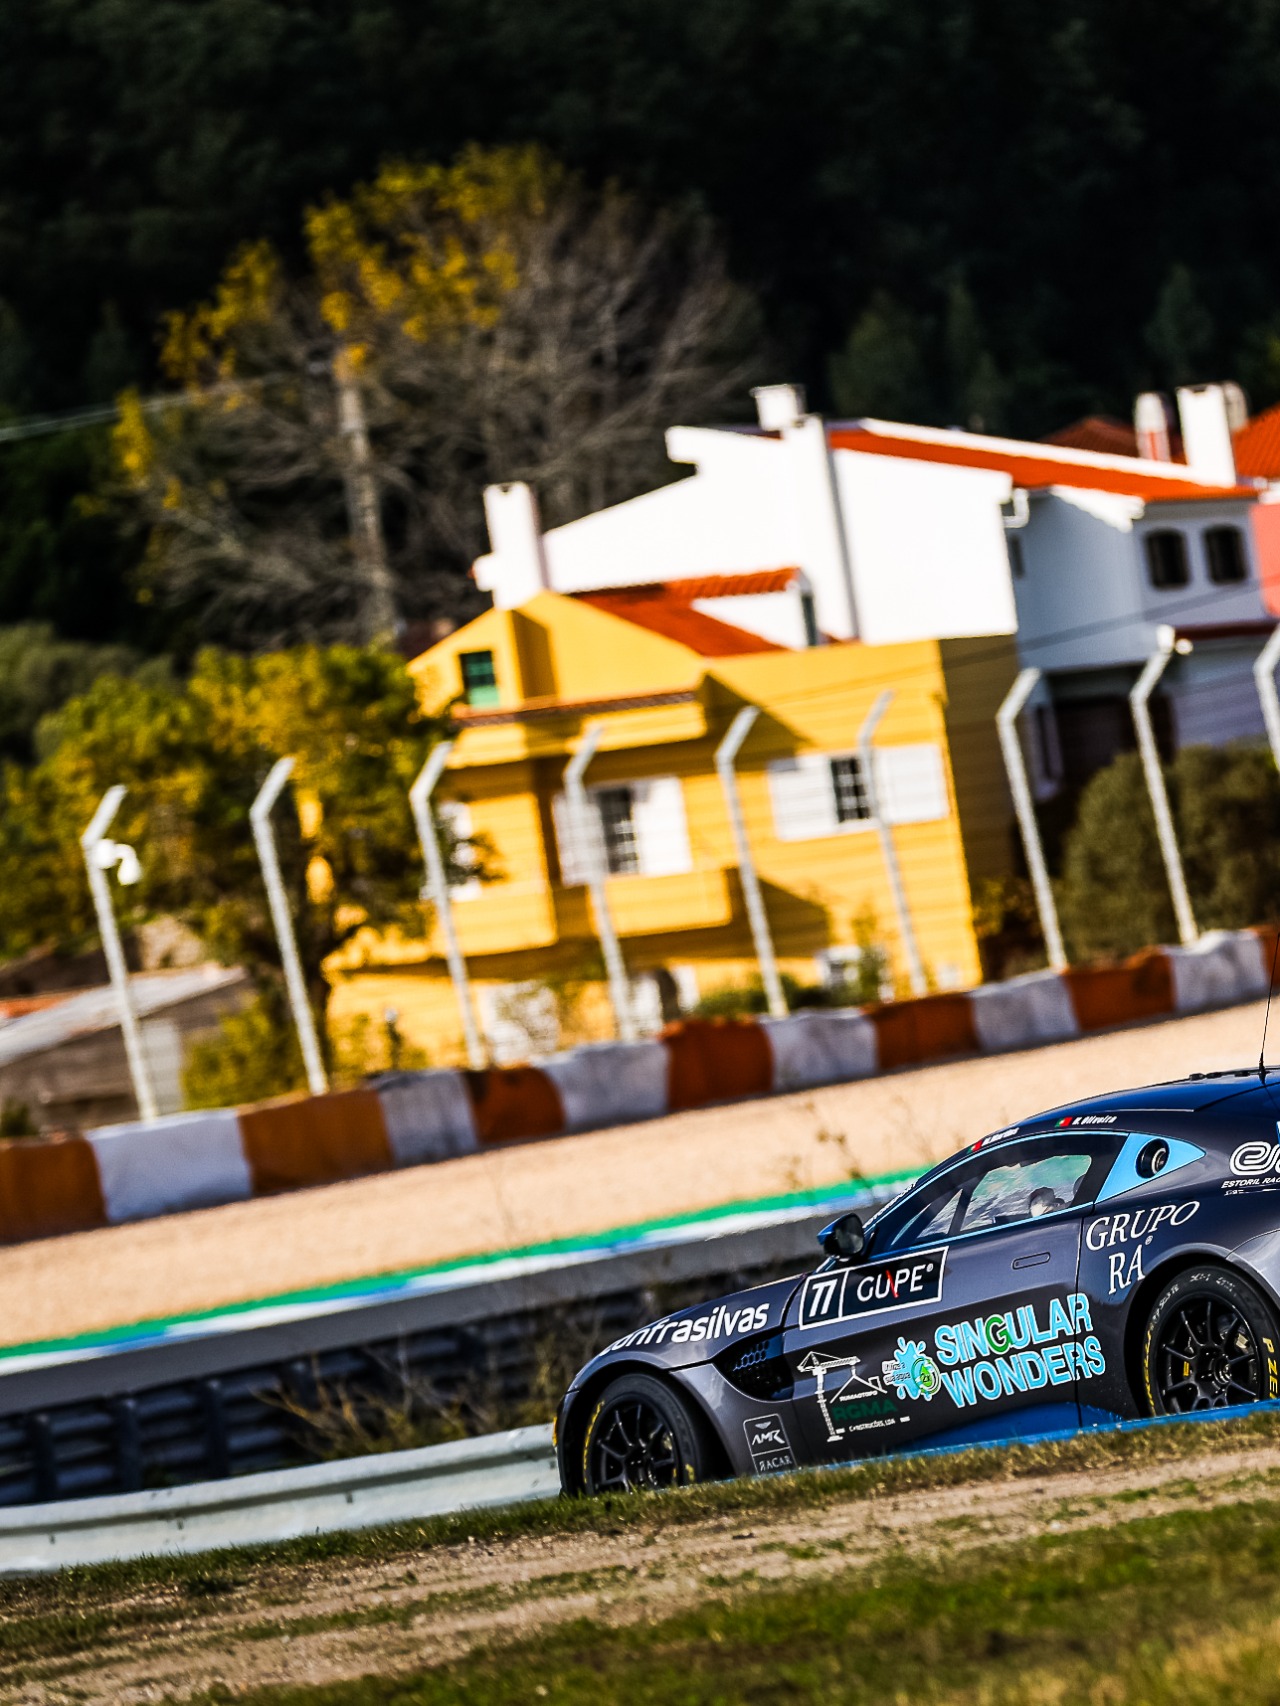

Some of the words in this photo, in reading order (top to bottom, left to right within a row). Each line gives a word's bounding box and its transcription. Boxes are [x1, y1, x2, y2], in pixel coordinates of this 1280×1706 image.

[1221, 1178, 1260, 1189] ESTORIL
[1086, 1201, 1200, 1251] GRUPO
[808, 1278, 838, 1318] 77
[934, 1292, 1094, 1366] SINGULAR
[940, 1335, 1106, 1408] WONDERS
[1267, 1357, 1278, 1399] ZE
[832, 1399, 898, 1421] RGMA
[752, 1429, 785, 1446] AMR
